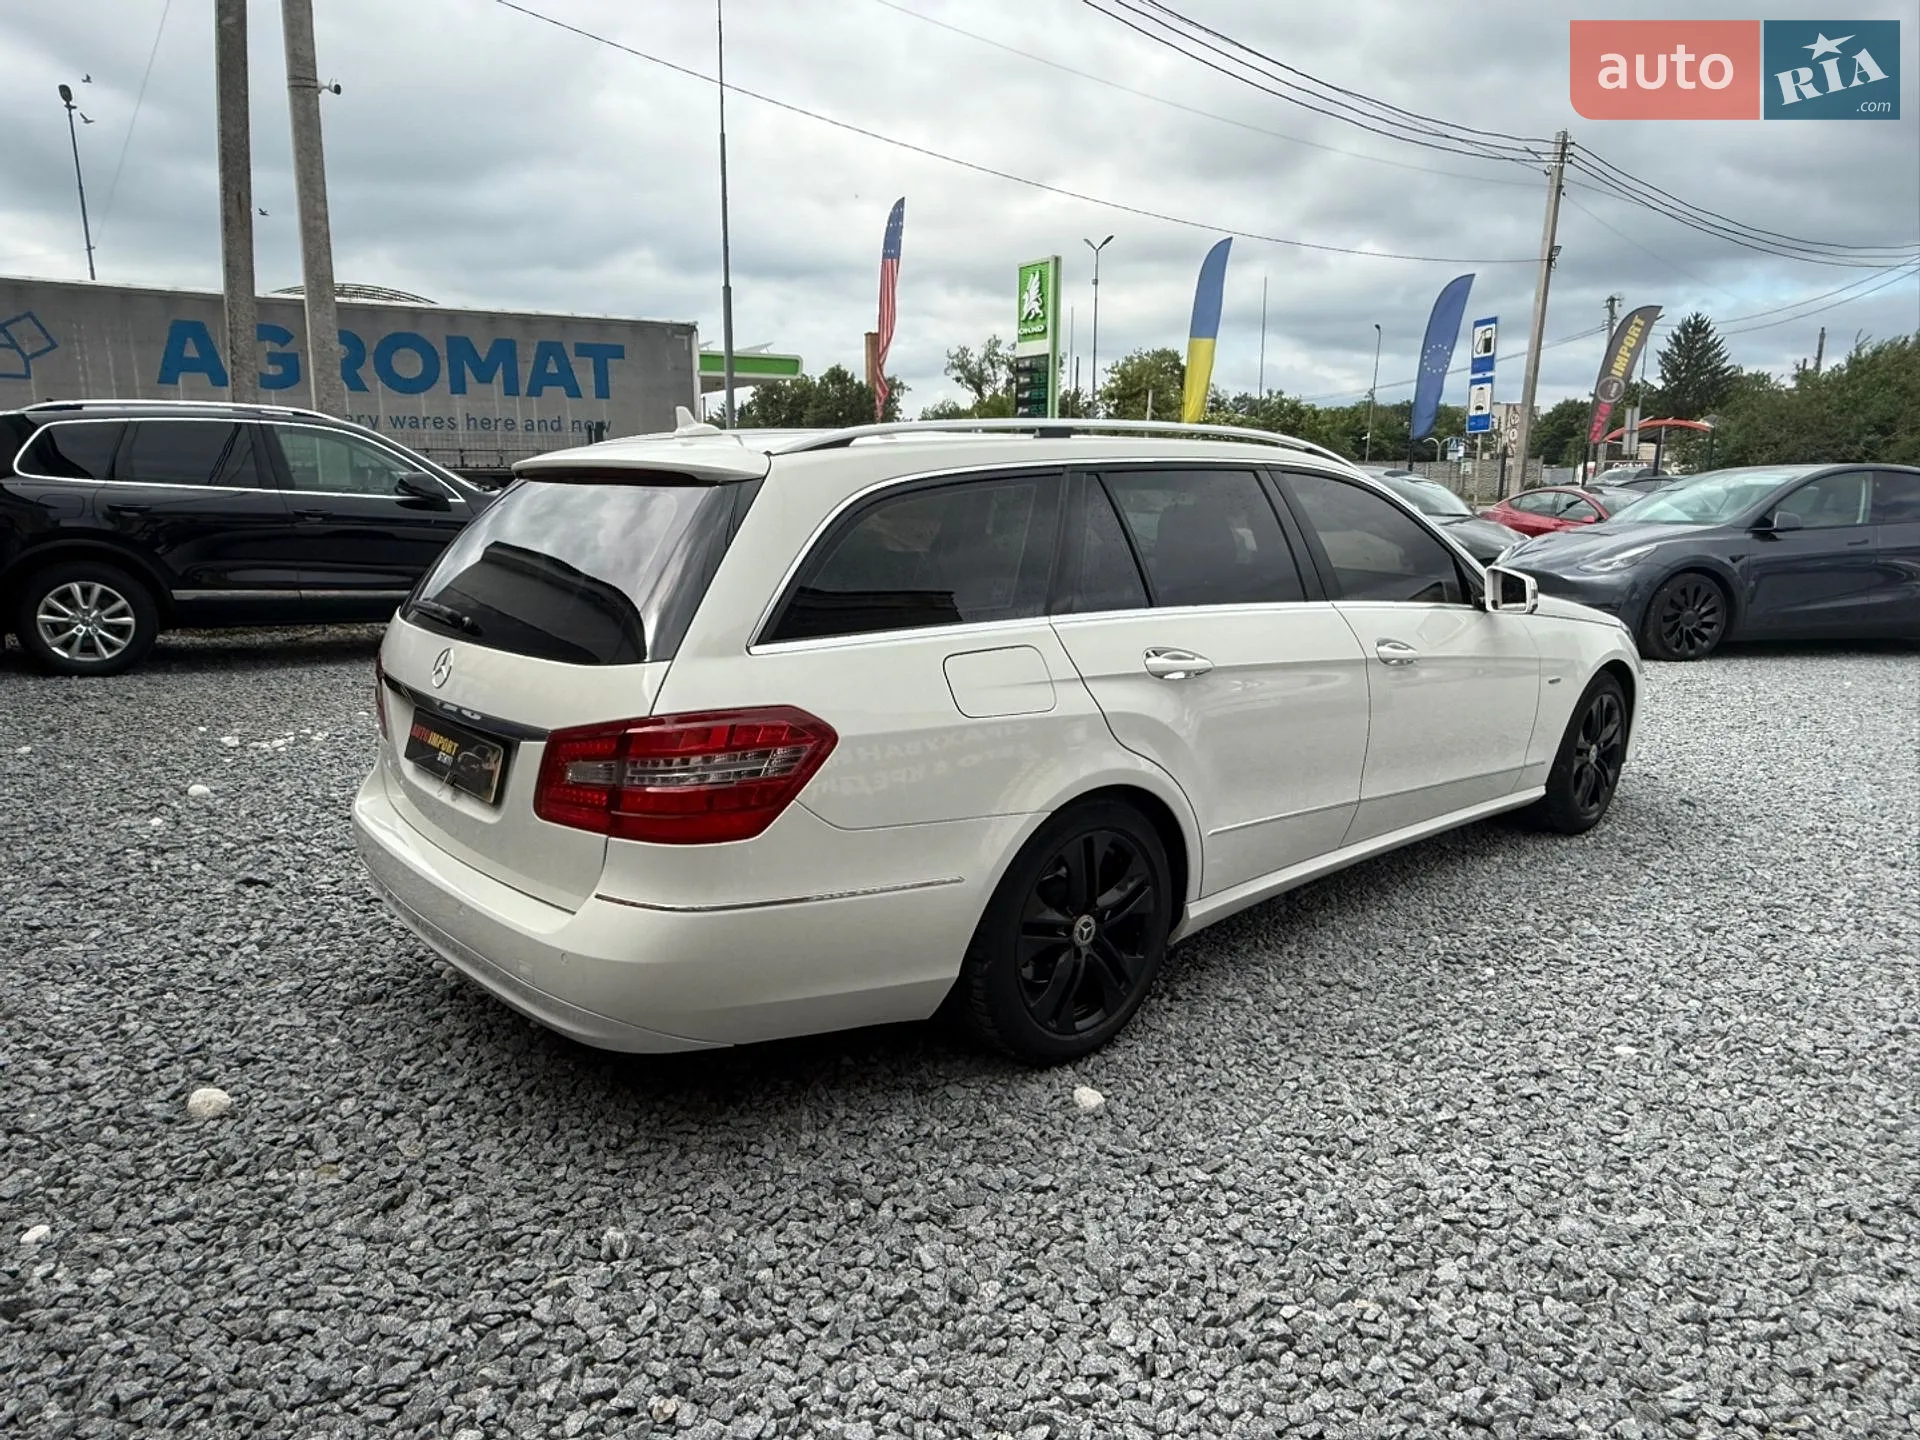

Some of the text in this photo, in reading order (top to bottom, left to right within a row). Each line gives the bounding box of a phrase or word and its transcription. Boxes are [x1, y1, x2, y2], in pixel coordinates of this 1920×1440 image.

[1611, 314, 1646, 377] IMPORT
[389, 415, 457, 431] wares
[465, 412, 516, 432] here
[524, 415, 563, 432] and
